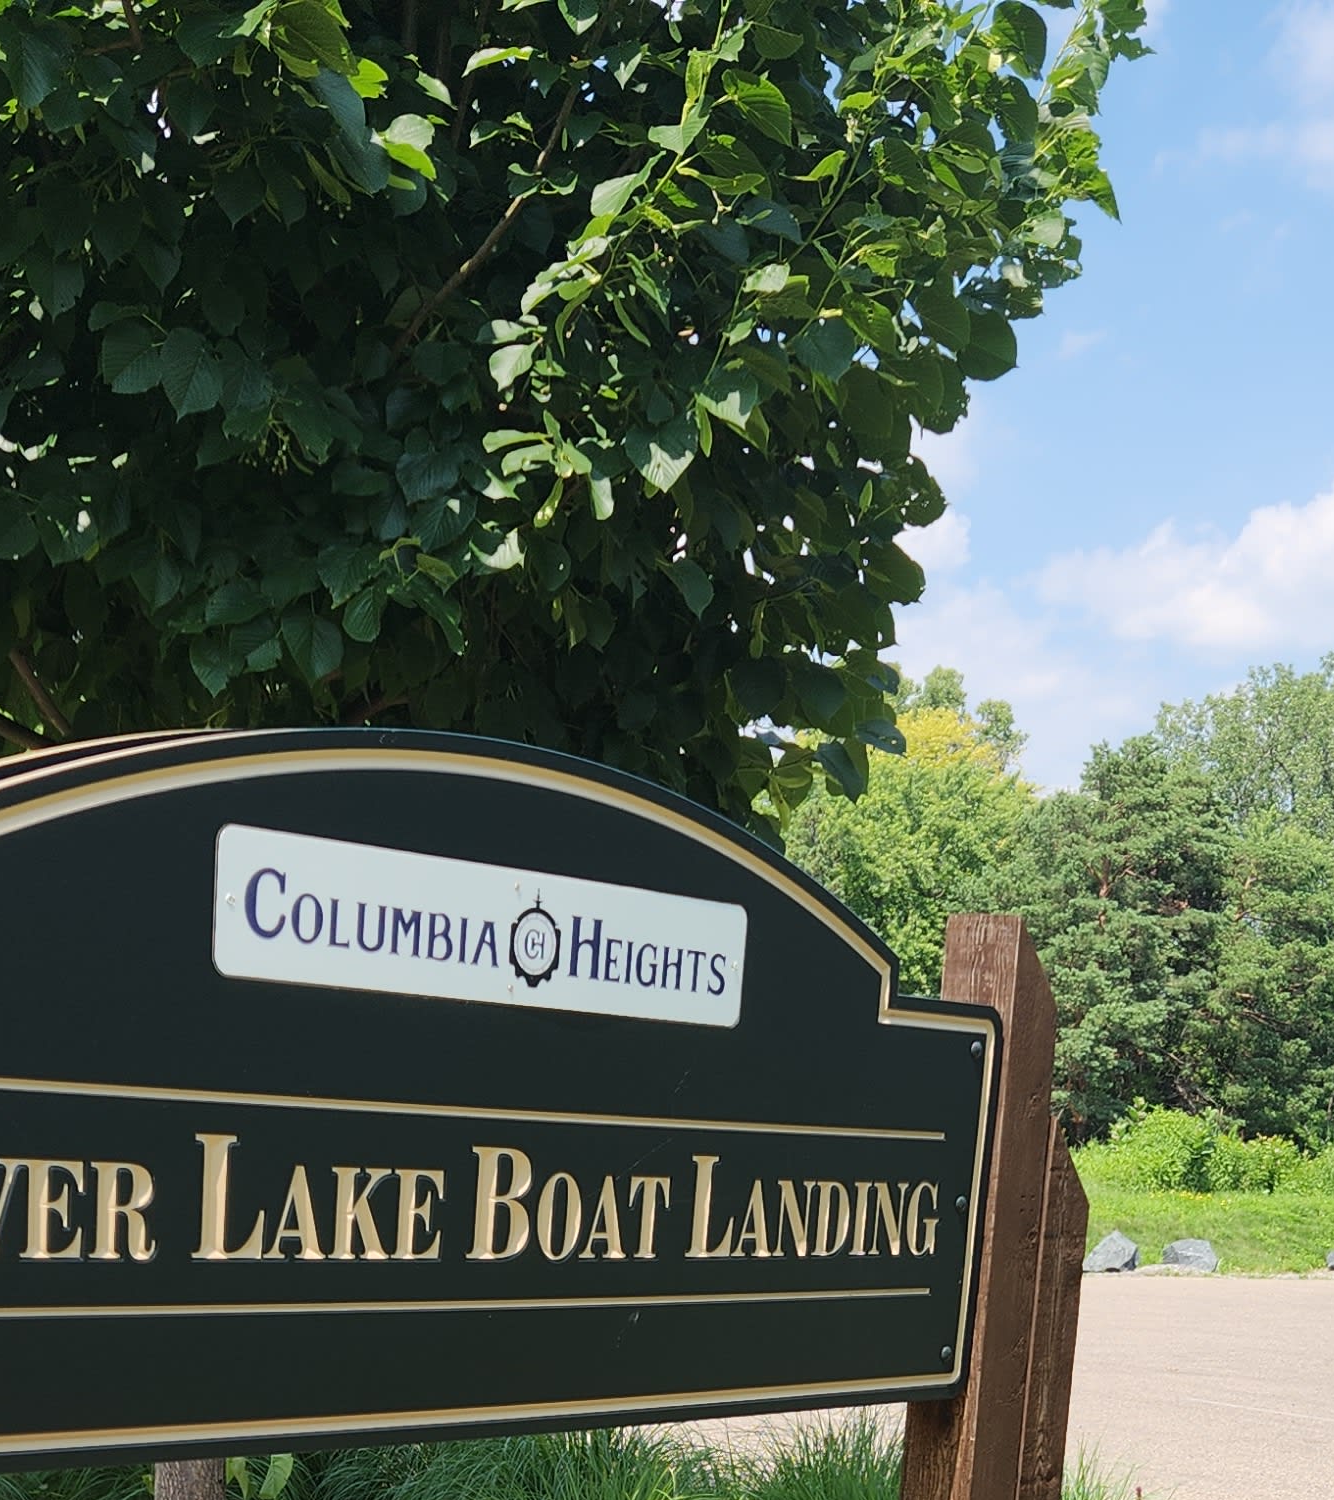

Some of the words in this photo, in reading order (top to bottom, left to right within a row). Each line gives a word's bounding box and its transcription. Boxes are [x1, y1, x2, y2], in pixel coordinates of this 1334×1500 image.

[244, 866, 500, 969] COLUMBIA
[568, 915, 727, 997] HEIGHTS
[190, 1132, 446, 1262] LAKE
[465, 1145, 672, 1263] BOAT
[683, 1154, 940, 1259] LANDING
